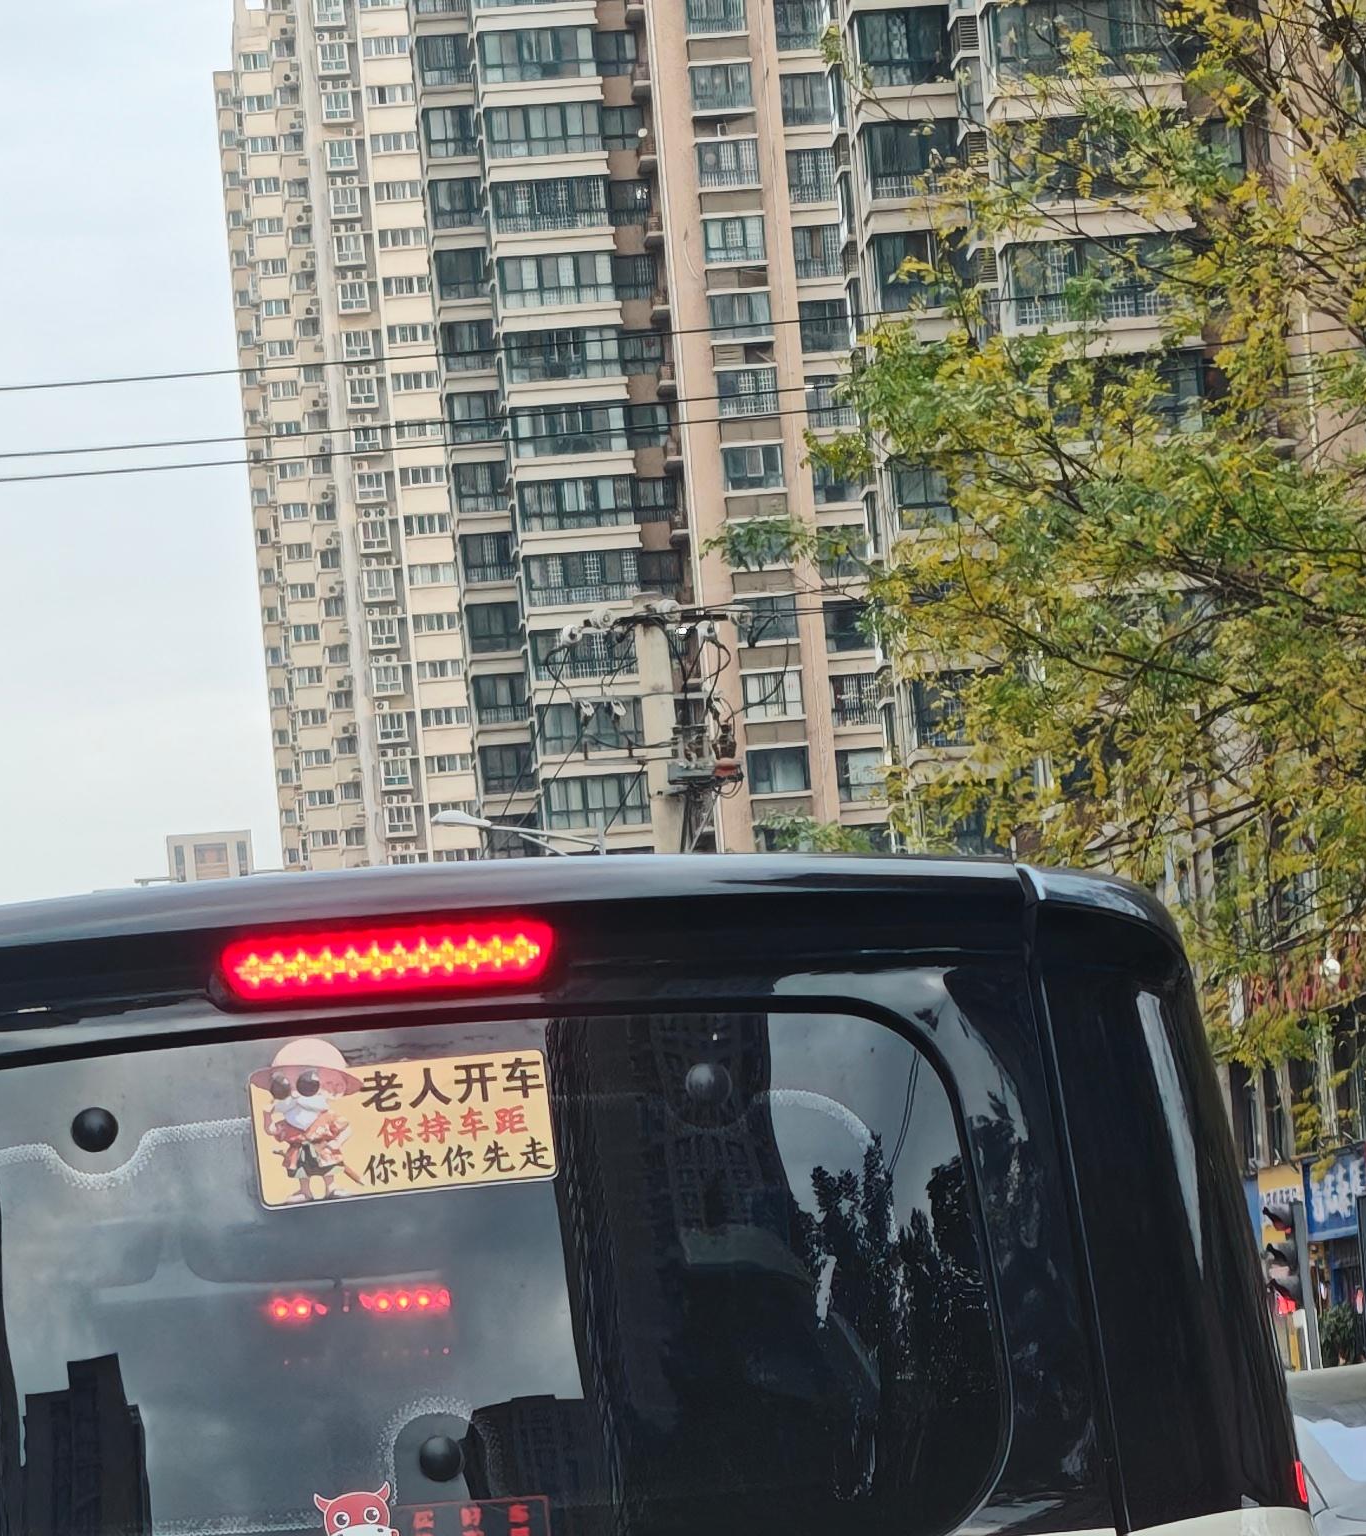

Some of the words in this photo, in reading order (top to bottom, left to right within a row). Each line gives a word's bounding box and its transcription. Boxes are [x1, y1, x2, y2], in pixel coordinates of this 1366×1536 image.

[360, 1057, 544, 1112] 老人开车
[378, 1105, 528, 1149] 保持车距
[363, 1136, 554, 1186] 你快你先走
